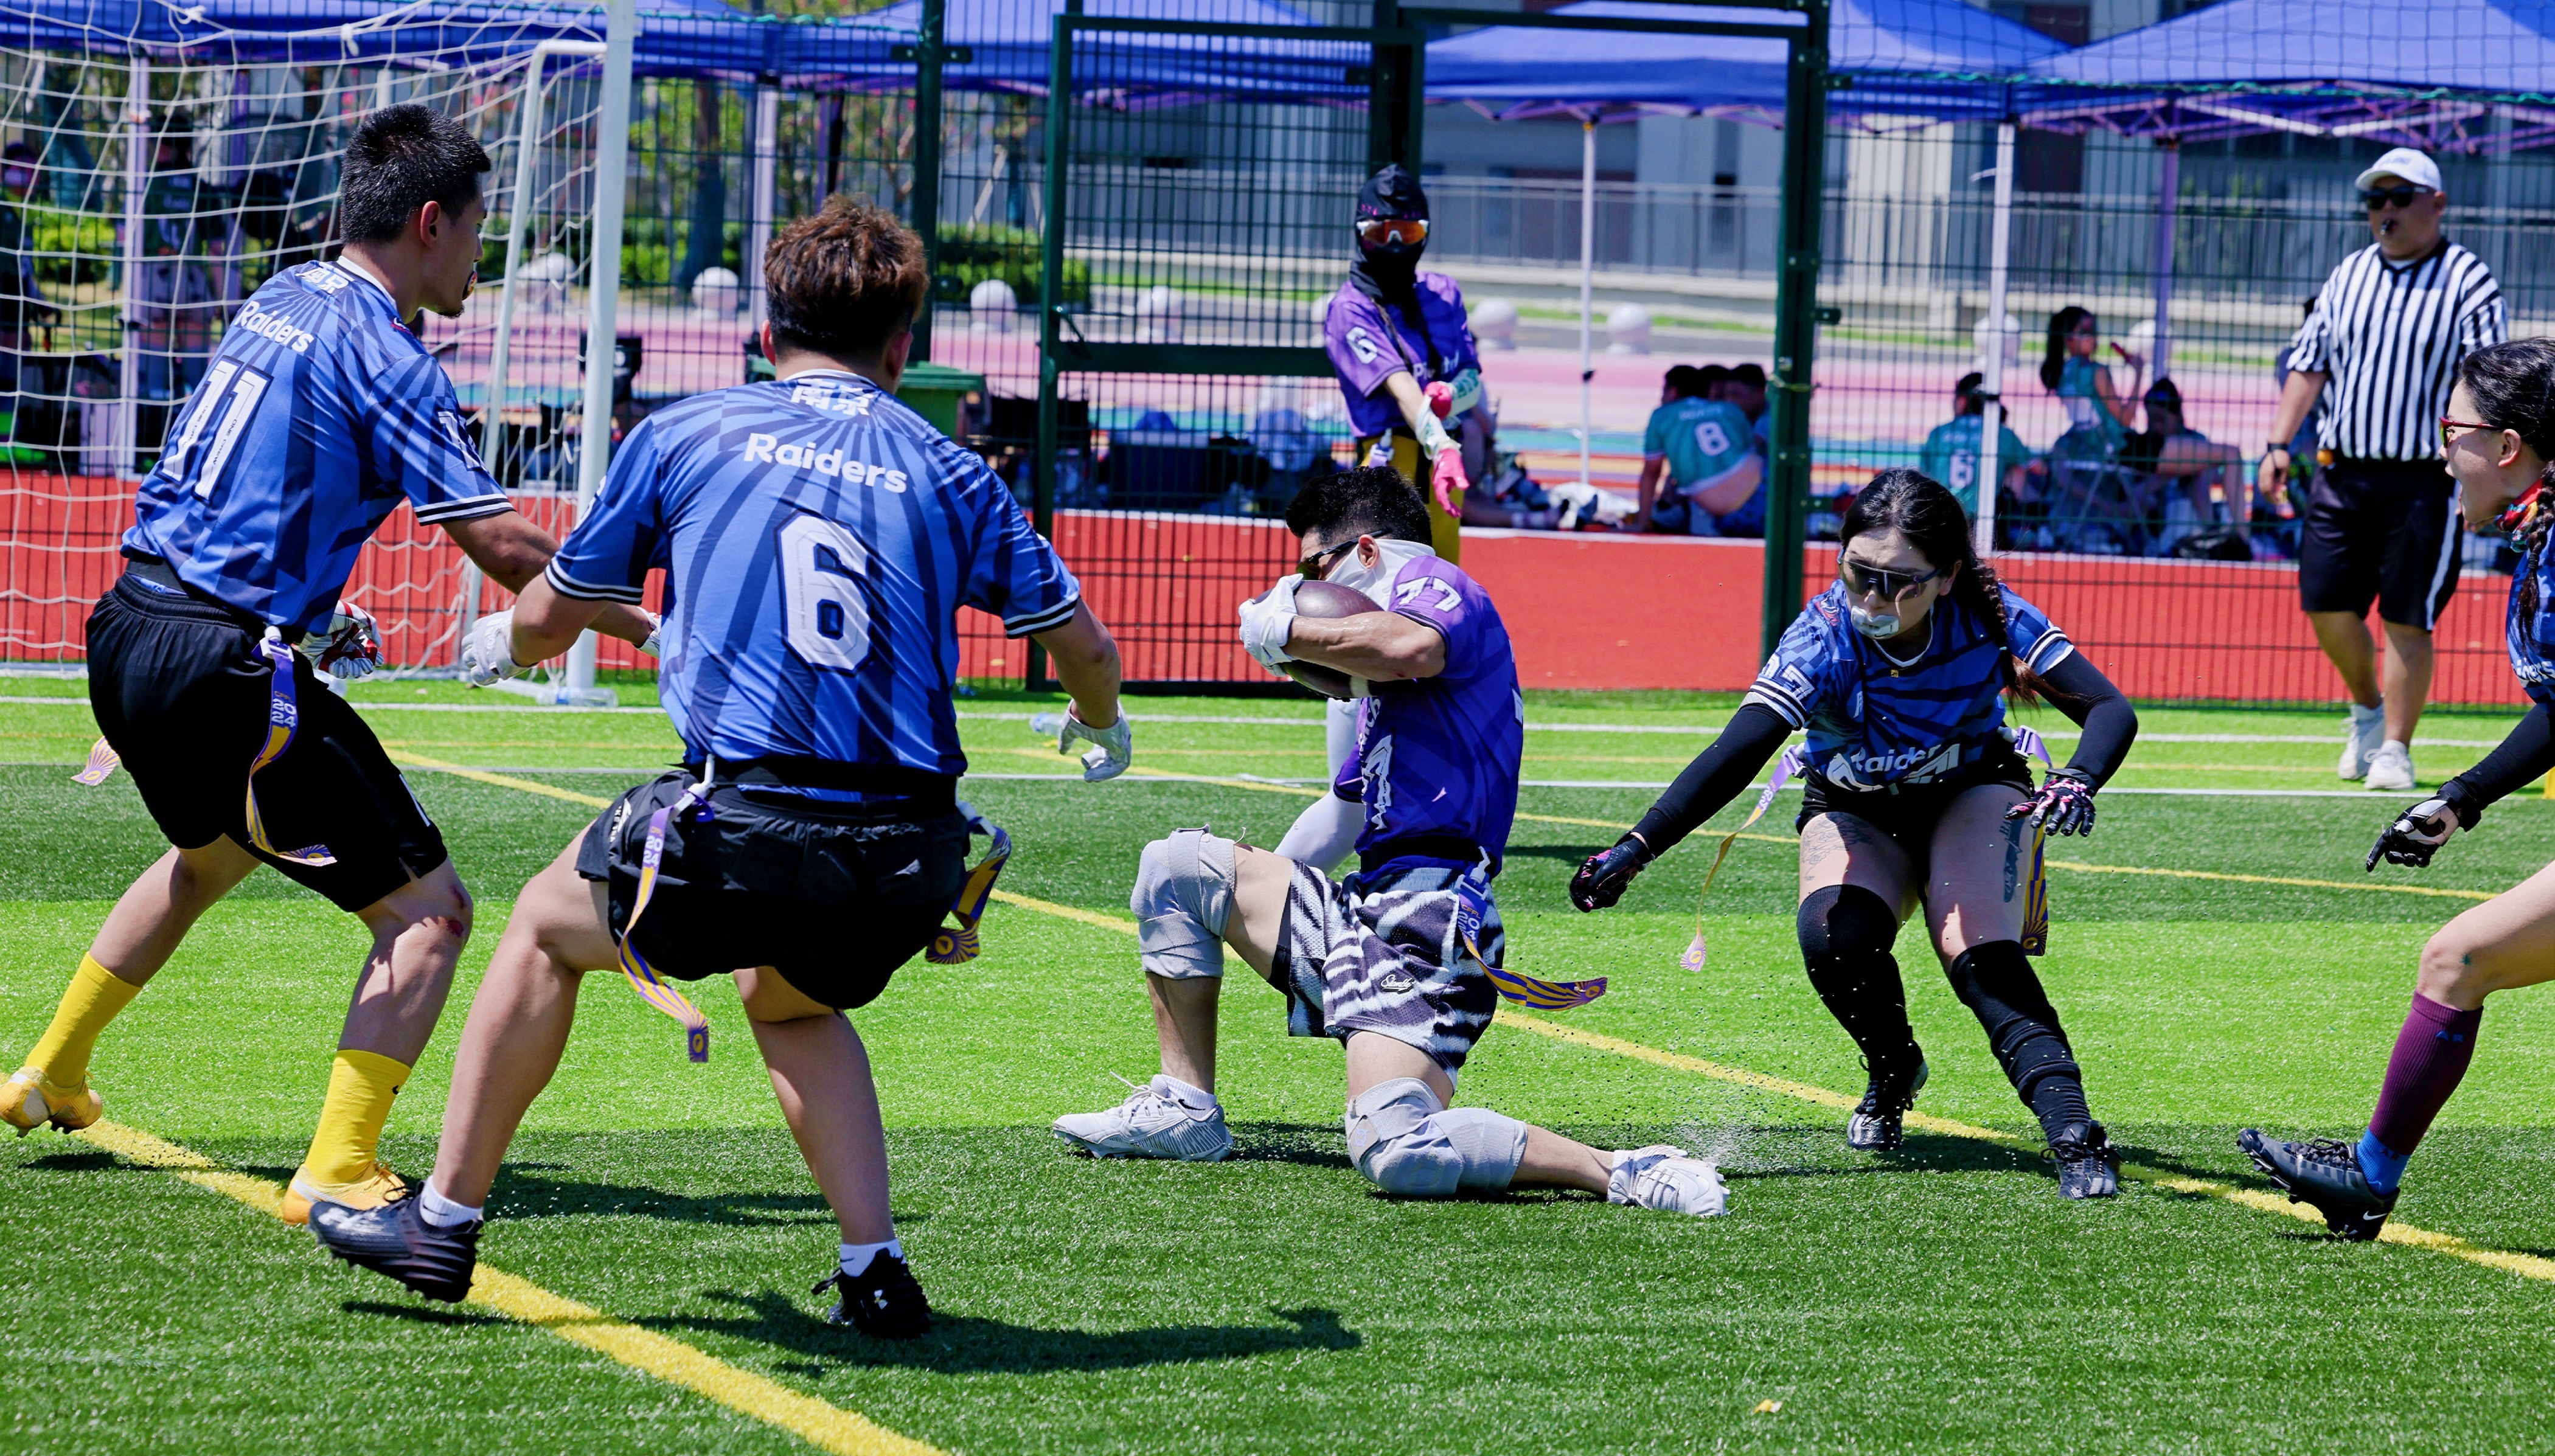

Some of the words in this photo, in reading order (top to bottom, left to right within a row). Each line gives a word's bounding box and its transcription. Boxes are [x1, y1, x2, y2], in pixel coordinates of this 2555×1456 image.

[234, 300, 315, 353] Raiders
[1346, 326, 1378, 364] 6
[157, 357, 271, 504] 11
[226, 419, 237, 437] ONE
[1695, 421, 1730, 456] 8
[743, 432, 908, 494] Raiders
[776, 512, 872, 673] 6
[1394, 576, 1462, 612] 77
[271, 710, 296, 727] 24
[272, 698, 296, 715] 20
[642, 850, 660, 867] 24
[645, 835, 664, 851] 20
[1458, 910, 1480, 930] 20
